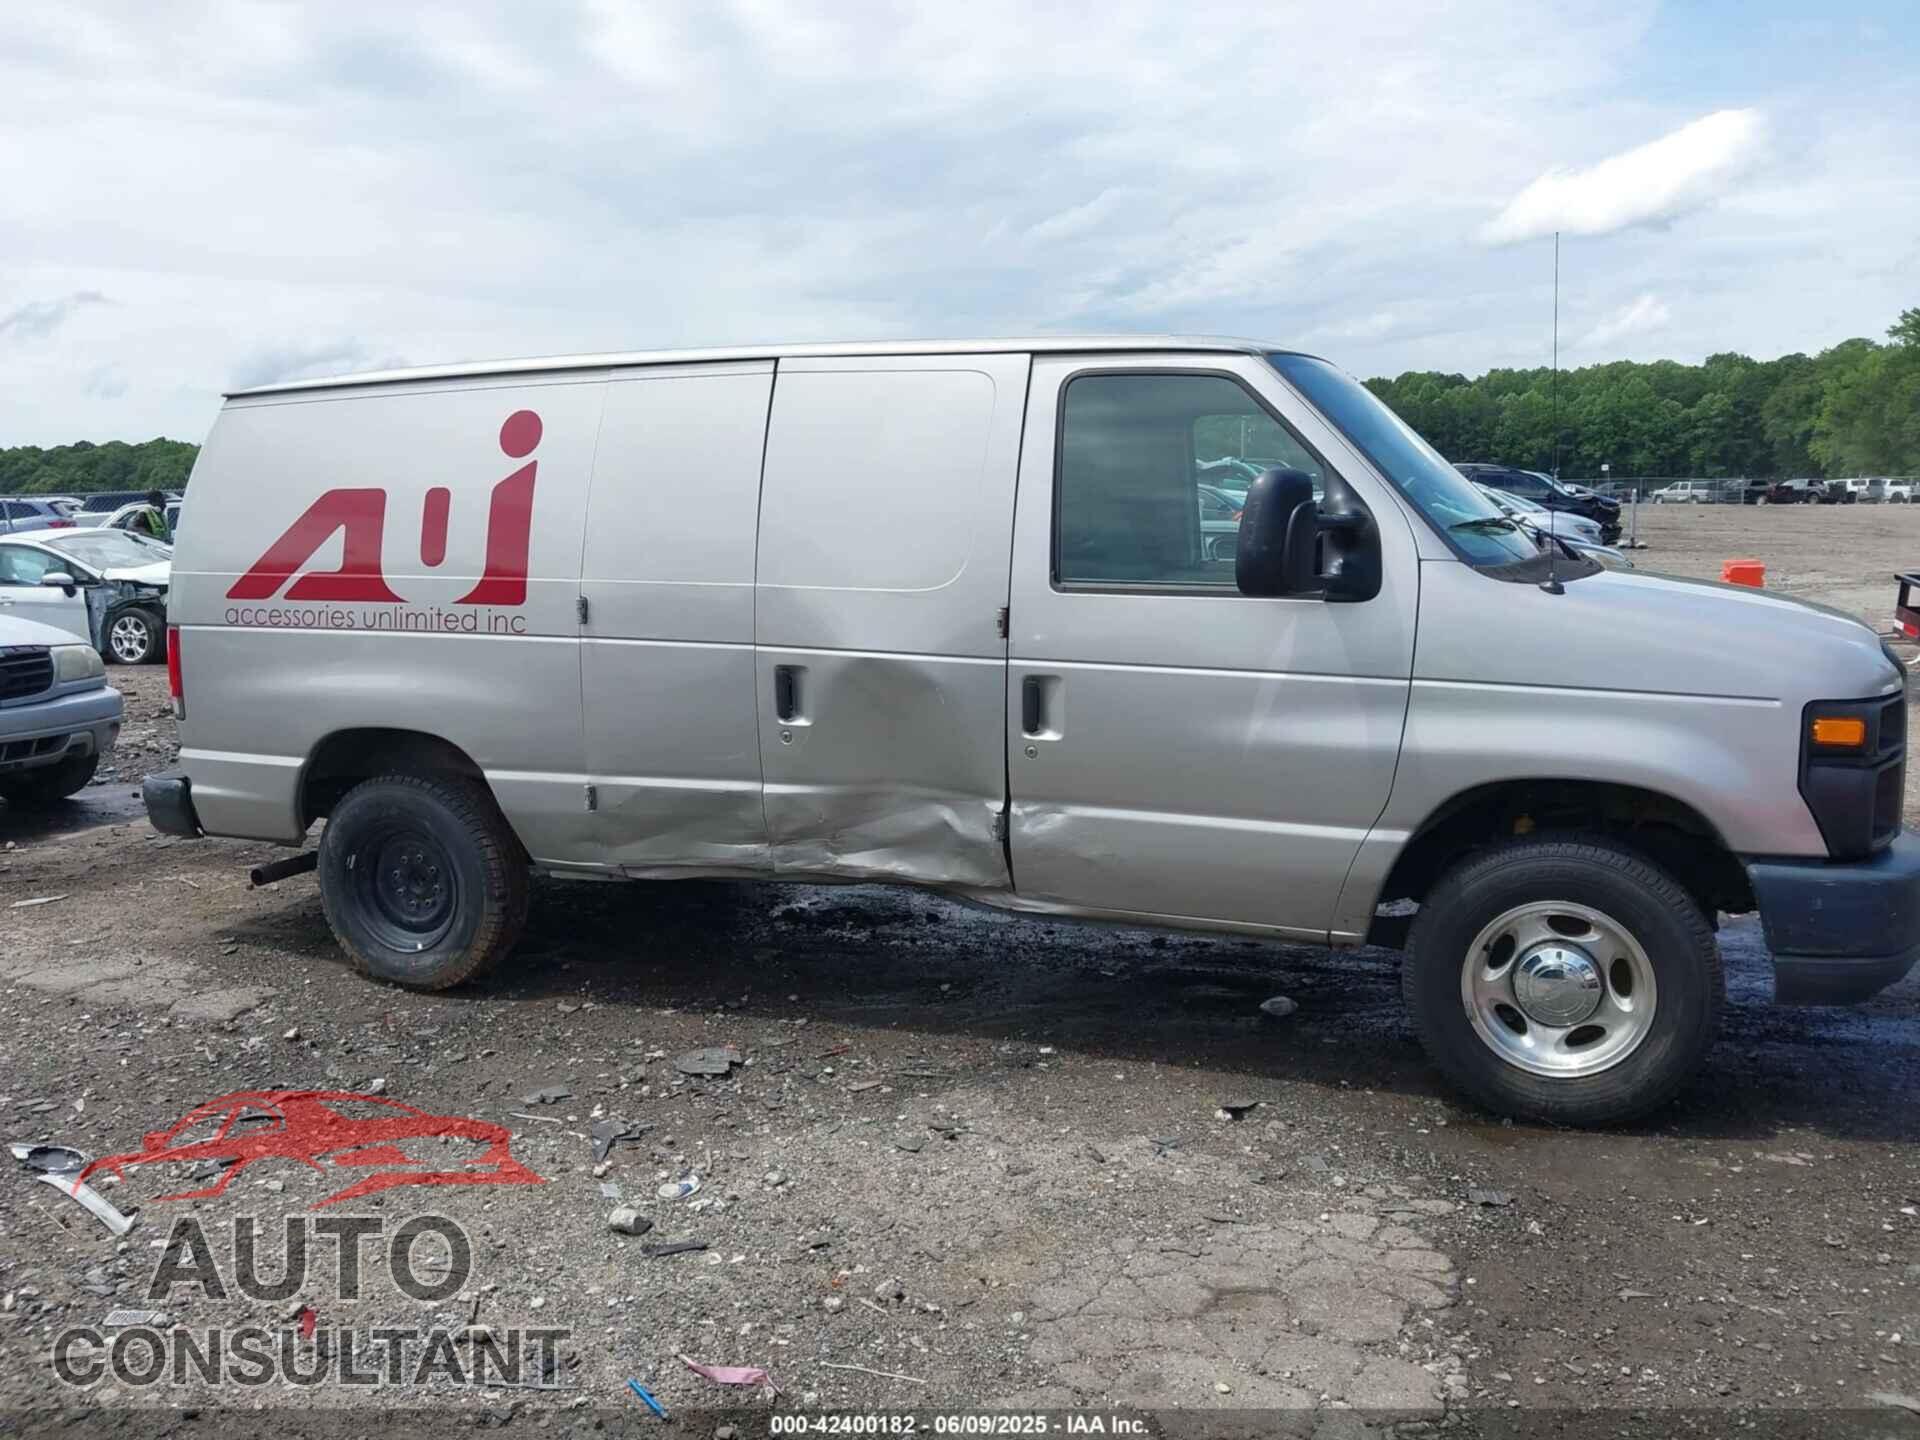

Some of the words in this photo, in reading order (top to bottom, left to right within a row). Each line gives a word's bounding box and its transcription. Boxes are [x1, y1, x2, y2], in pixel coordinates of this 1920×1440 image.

[225, 604, 355, 628] accessories
[363, 606, 477, 632] unlimited
[487, 609, 526, 633] inc
